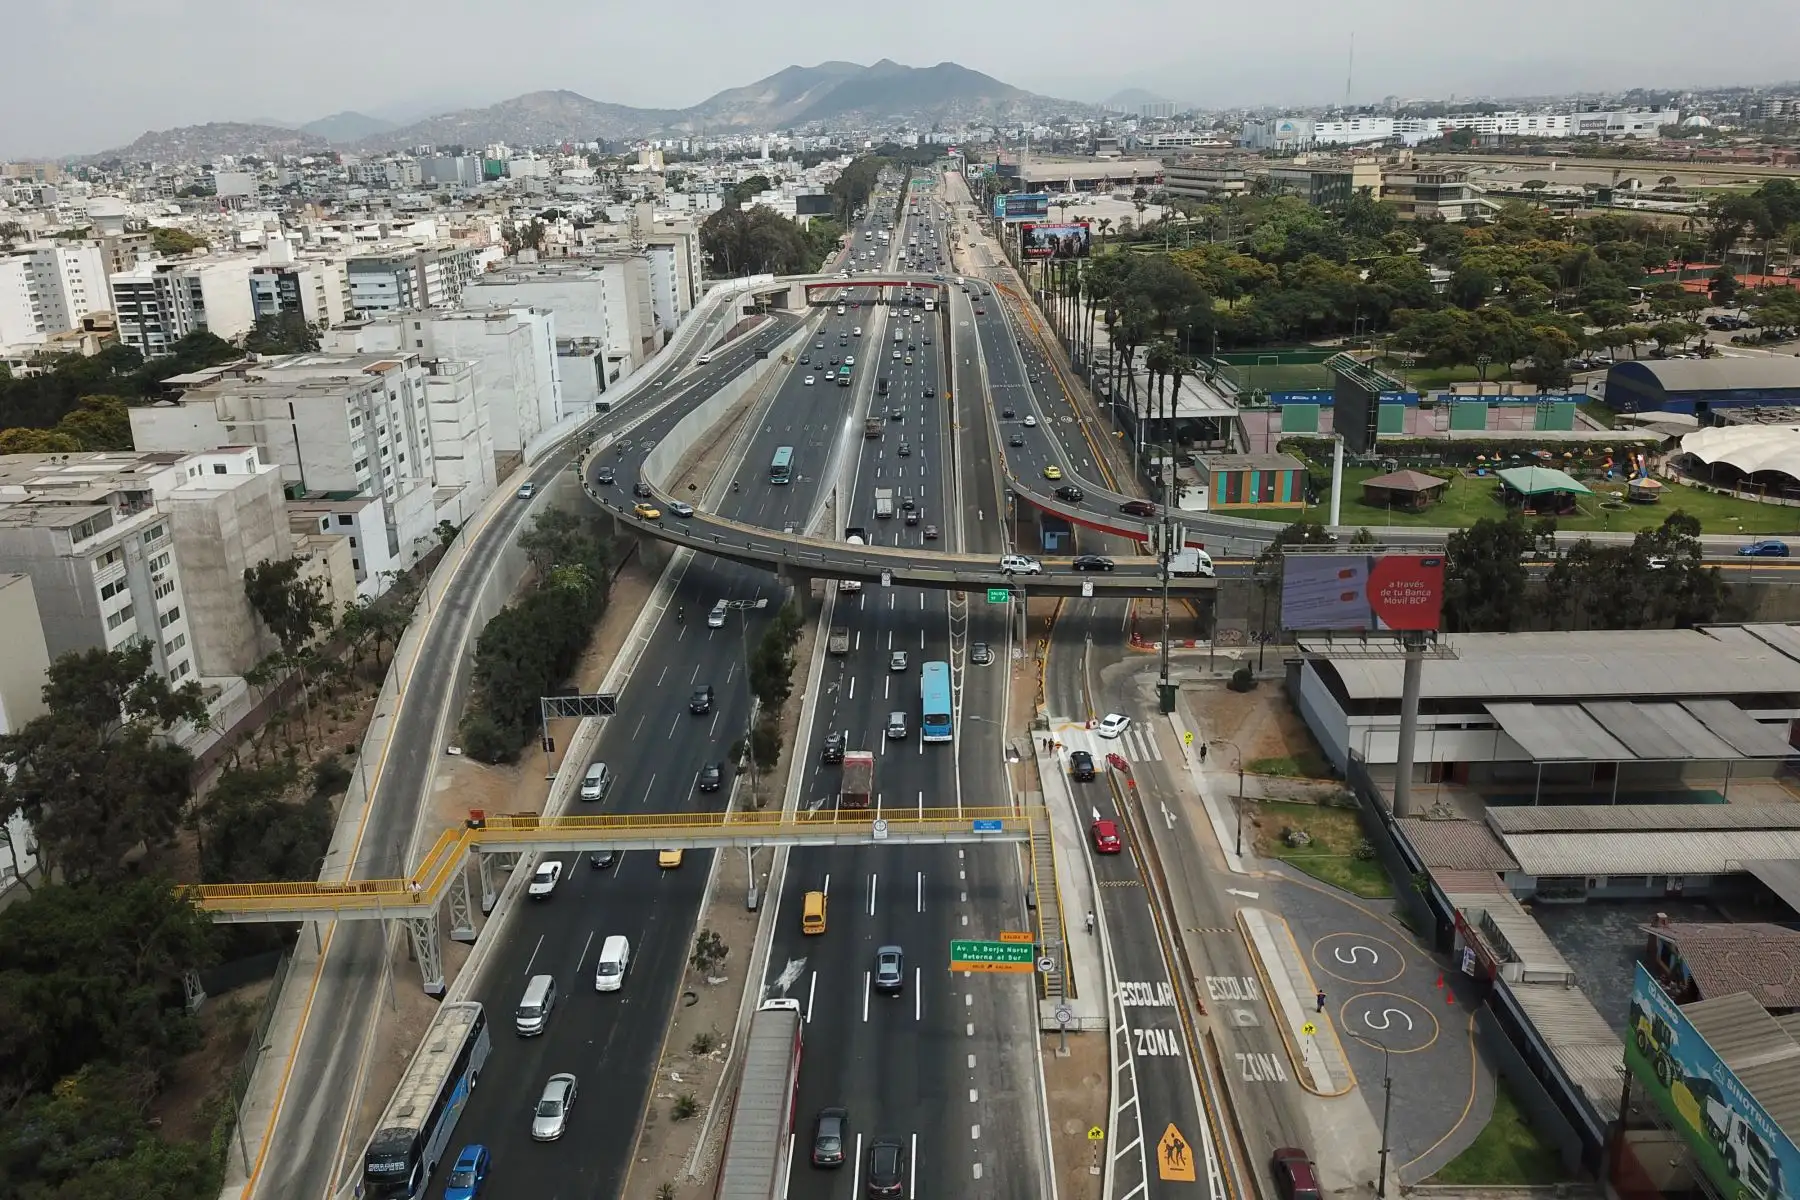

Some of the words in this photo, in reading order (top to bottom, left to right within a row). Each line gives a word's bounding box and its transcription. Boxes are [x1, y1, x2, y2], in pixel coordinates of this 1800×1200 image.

[1381, 588, 1391, 596] de
[1405, 588, 1432, 596] Banca
[1384, 596, 1408, 604] Móvil
[1409, 596, 1427, 604] BCP
[983, 945, 1003, 954] Borja
[1119, 981, 1177, 1007] ESCOLAR
[1133, 1028, 1181, 1057] ZONA
[1234, 1052, 1289, 1083] ZONA
[1726, 1077, 1778, 1143] SINOTRUK
